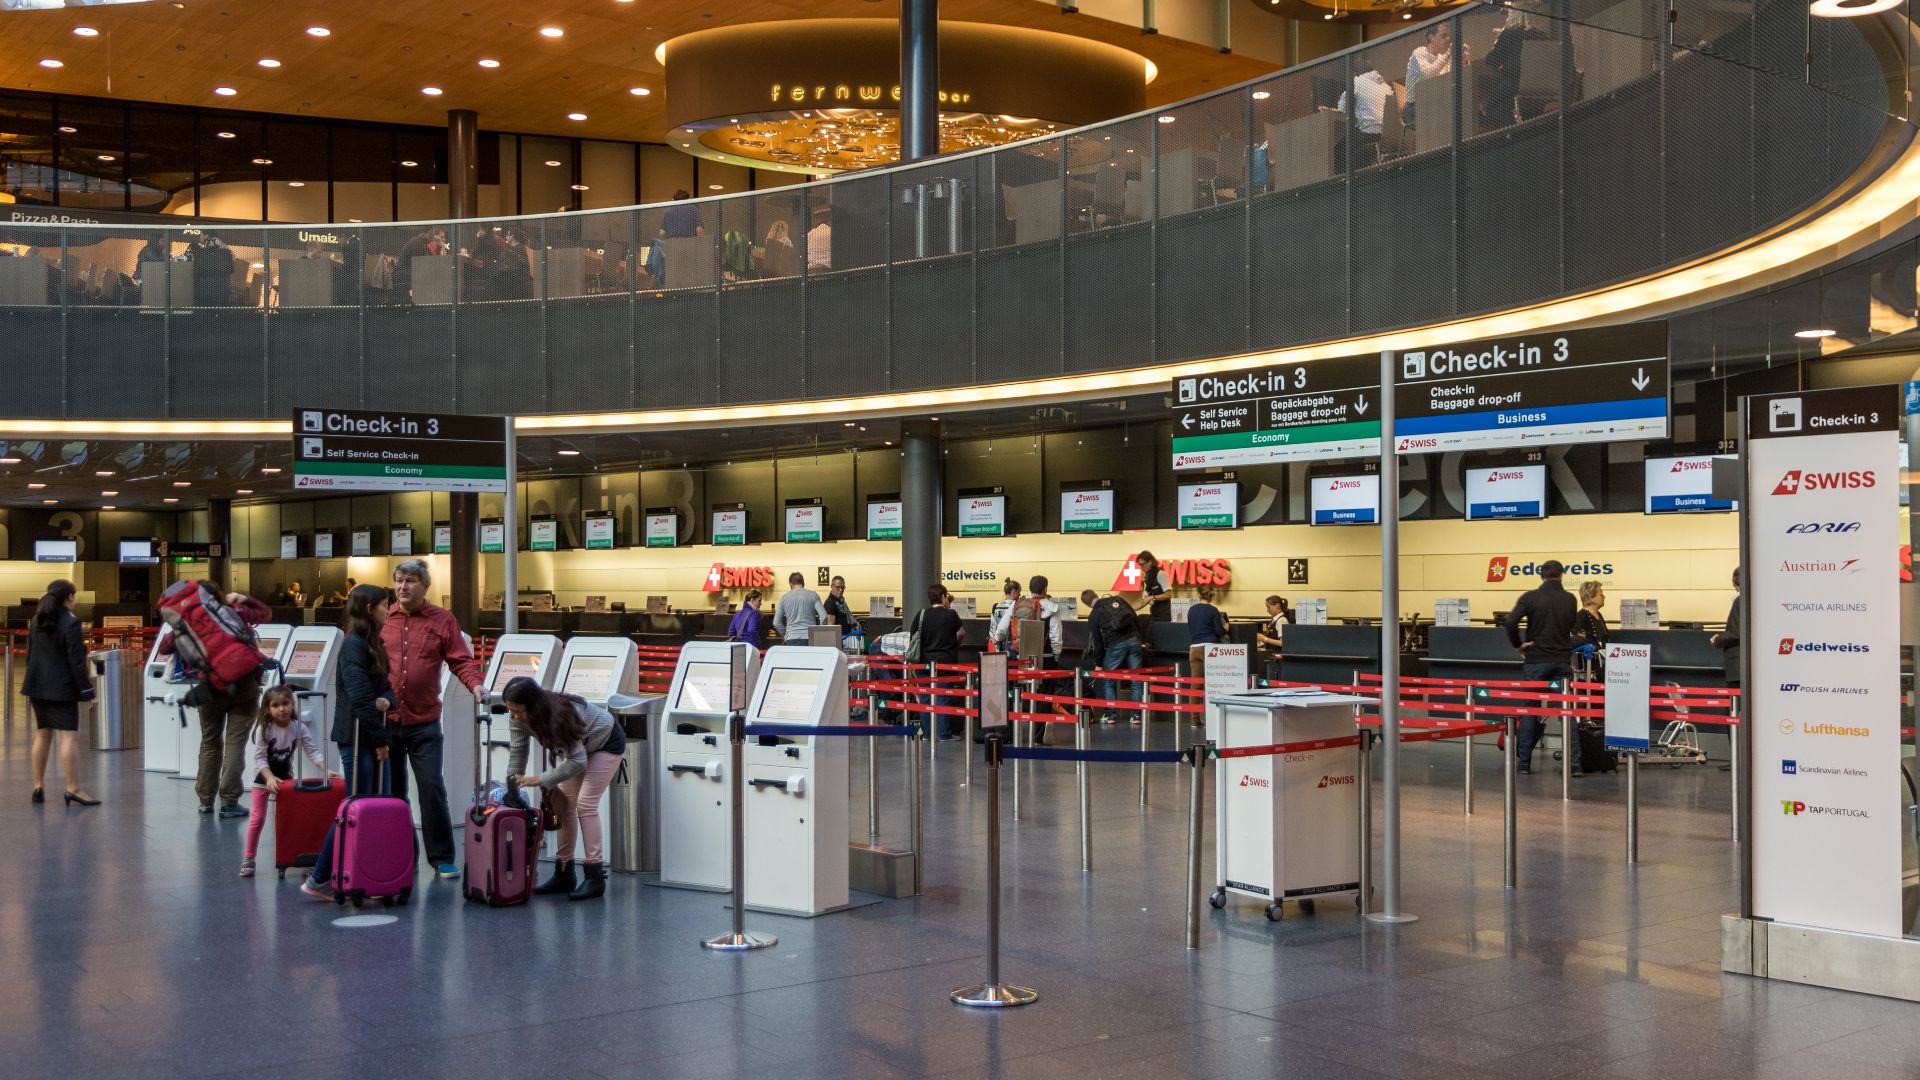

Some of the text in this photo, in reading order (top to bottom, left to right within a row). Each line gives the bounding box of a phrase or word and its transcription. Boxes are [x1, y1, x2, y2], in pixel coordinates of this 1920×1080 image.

[771, 84, 900, 102] fernwe
[1430, 337, 1569, 374] Check-in 3
[1199, 367, 1306, 398] Check-in 3
[1430, 384, 1475, 397] Check-in
[1271, 395, 1334, 410] Gepäckabgabe
[1430, 392, 1521, 410] Baggage drop-off
[1200, 407, 1248, 419] Self Service
[1271, 405, 1347, 423] Baggage drop-off
[1497, 412, 1547, 424] Business
[326, 413, 439, 435] Check-in 3
[1200, 418, 1241, 431] Help Desk
[1809, 412, 1879, 427] Check-in 3
[1252, 433, 1289, 443] Economy
[1410, 439, 1437, 448] SWISS
[1718, 440, 1734, 449] 312
[327, 449, 419, 460] Self Service Check-in
[1184, 455, 1205, 464] SWISS
[1527, 453, 1541, 461] 313
[385, 466, 423, 475] Economy
[1364, 464, 1376, 472] 314
[1683, 461, 1712, 471] SWISS
[1498, 472, 1523, 480] SWISS
[1804, 470, 1876, 490] SWISS
[309, 478, 334, 486] SWISS
[1202, 488, 1221, 496] SWISS
[1675, 498, 1706, 506] Business
[1490, 505, 1517, 513] Business
[1786, 522, 1861, 534] ADRIA
[1510, 561, 1614, 576] edeeiss
[1780, 560, 1836, 571] Austrian
[723, 566, 773, 588] SWISS
[1157, 558, 1231, 586] WISS
[1786, 603, 1824, 611] CROATIA
[1219, 648, 1245, 656] SWISS
[1795, 642, 1870, 652] edelweiss
[1621, 649, 1648, 657] SWISS
[1607, 670, 1631, 678] Check-in
[1780, 683, 1800, 692] LOT
[1803, 722, 1870, 737] Lufthansa
[1284, 753, 1314, 763] Check-in
[1799, 765, 1841, 775] Scandinavian
[1843, 768, 1868, 776] Airlines
[1329, 775, 1355, 785] SWISS
[1809, 806, 1824, 814] TAP
[1824, 807, 1870, 818] PORTUGAL
[1232, 881, 1244, 889] STAR
